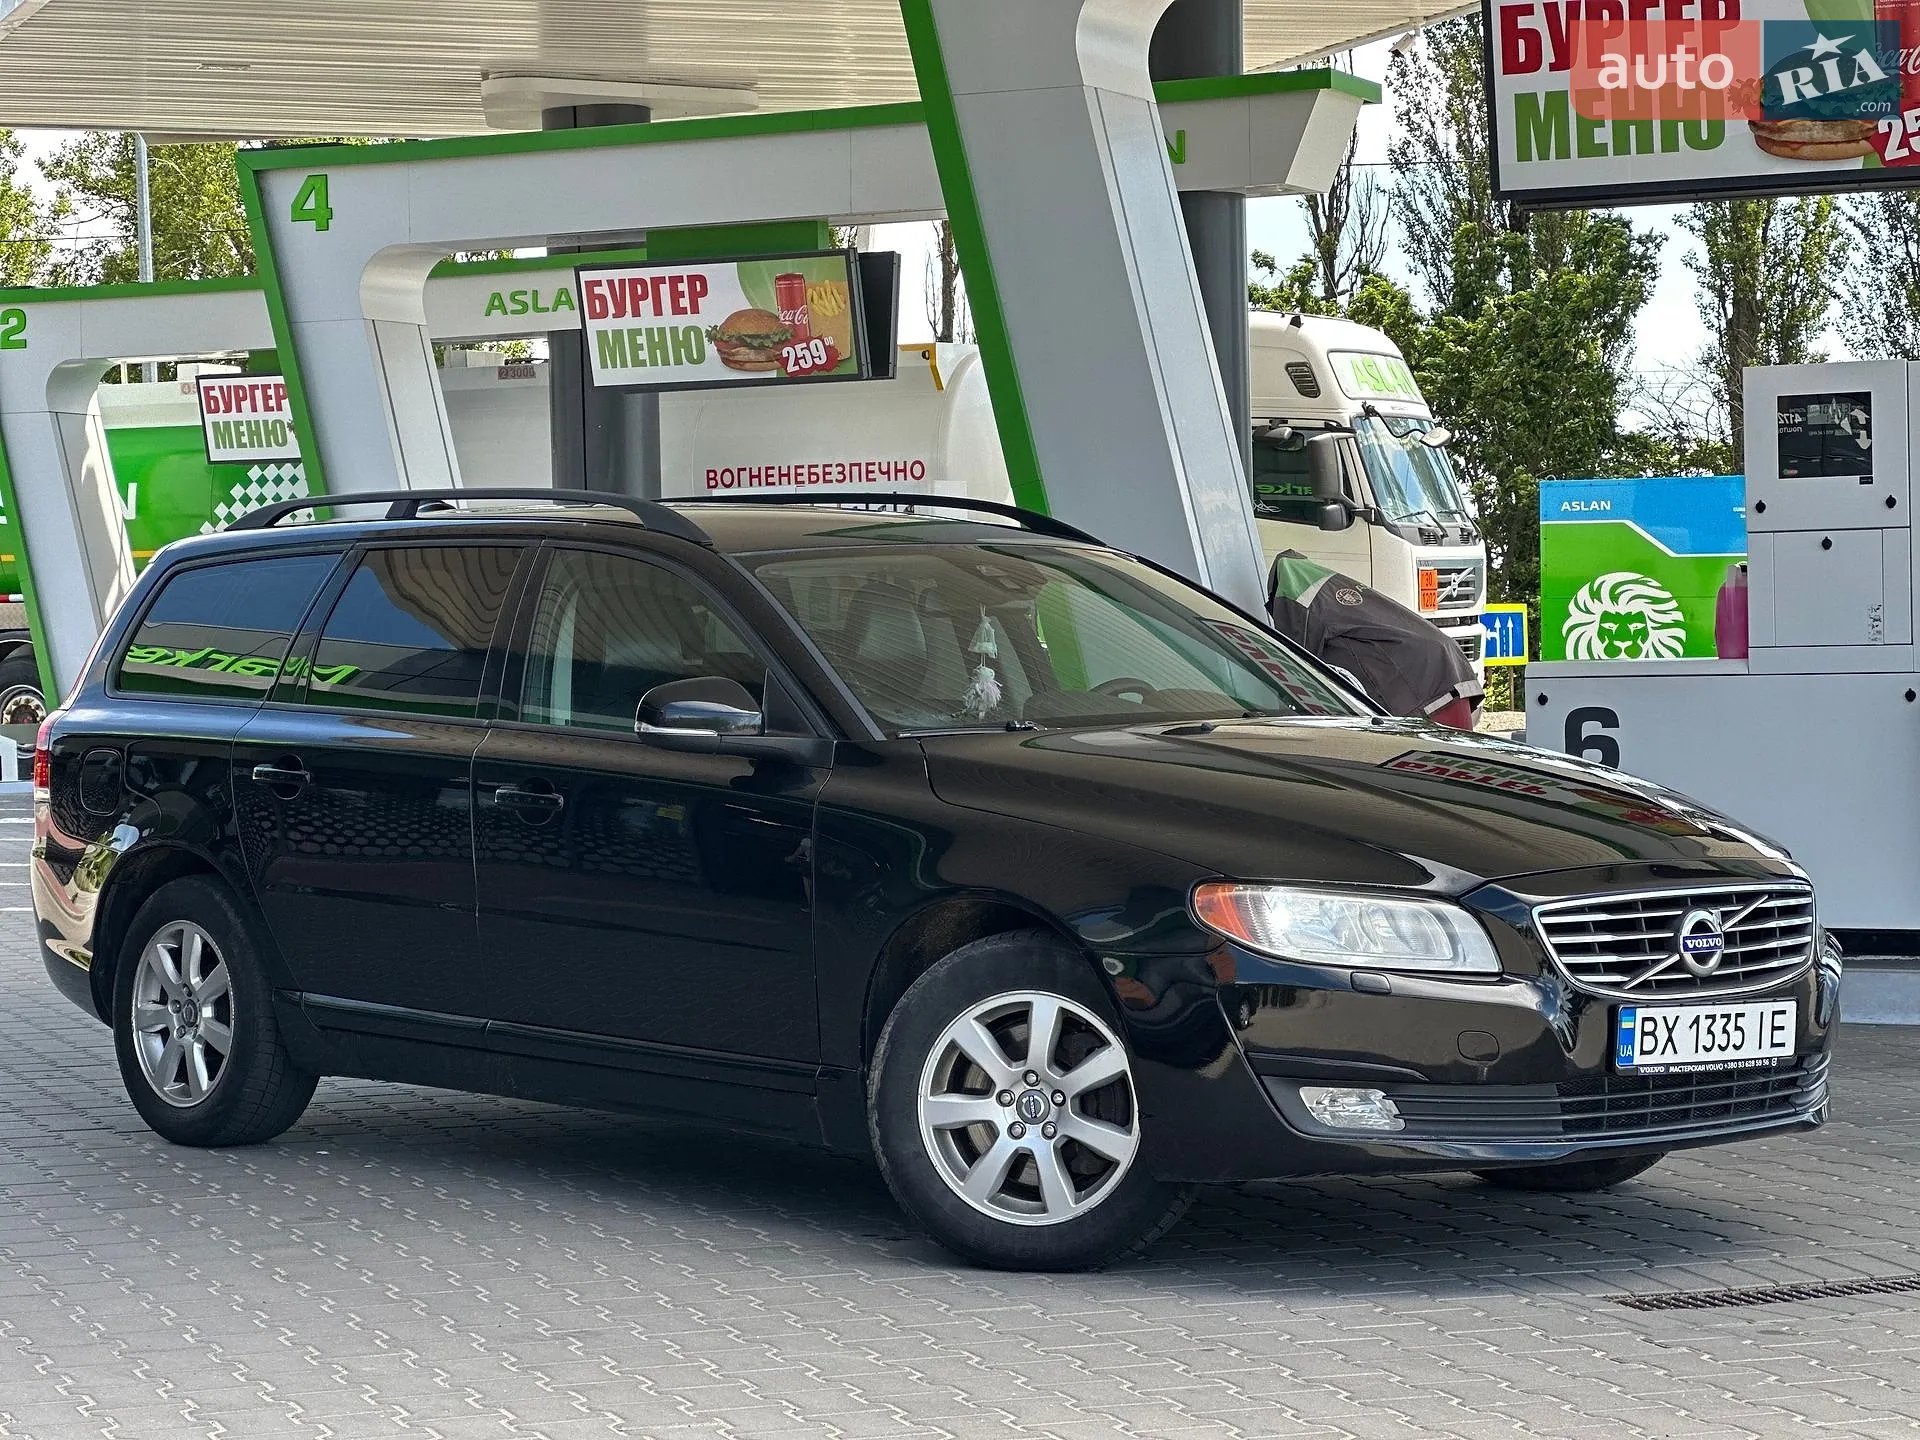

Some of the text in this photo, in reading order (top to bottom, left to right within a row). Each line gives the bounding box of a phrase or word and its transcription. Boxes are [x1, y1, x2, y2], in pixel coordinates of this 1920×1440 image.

[1499, 0, 1742, 75] БУРГЕР
[1514, 82, 1727, 163] МЕНЮ
[291, 174, 333, 231] 4
[484, 287, 575, 317] ASLA
[584, 273, 709, 321] БУРГЕР
[0, 308, 27, 350] 2
[595, 325, 706, 370] МЕНЮ
[782, 338, 827, 373] 259
[203, 383, 288, 415] БУРГЕР
[212, 419, 288, 449] МЕНЮ
[706, 459, 927, 490] ВОГНЕНЕБЕЗПЕЧНО
[1561, 500, 1611, 512] ASLAN
[1565, 706, 1620, 770] 6
[1685, 938, 1722, 949] VOLVO
[1620, 1044, 1633, 1057] UA
[1639, 1015, 1680, 1056] BX
[1688, 1012, 1746, 1053] 1335
